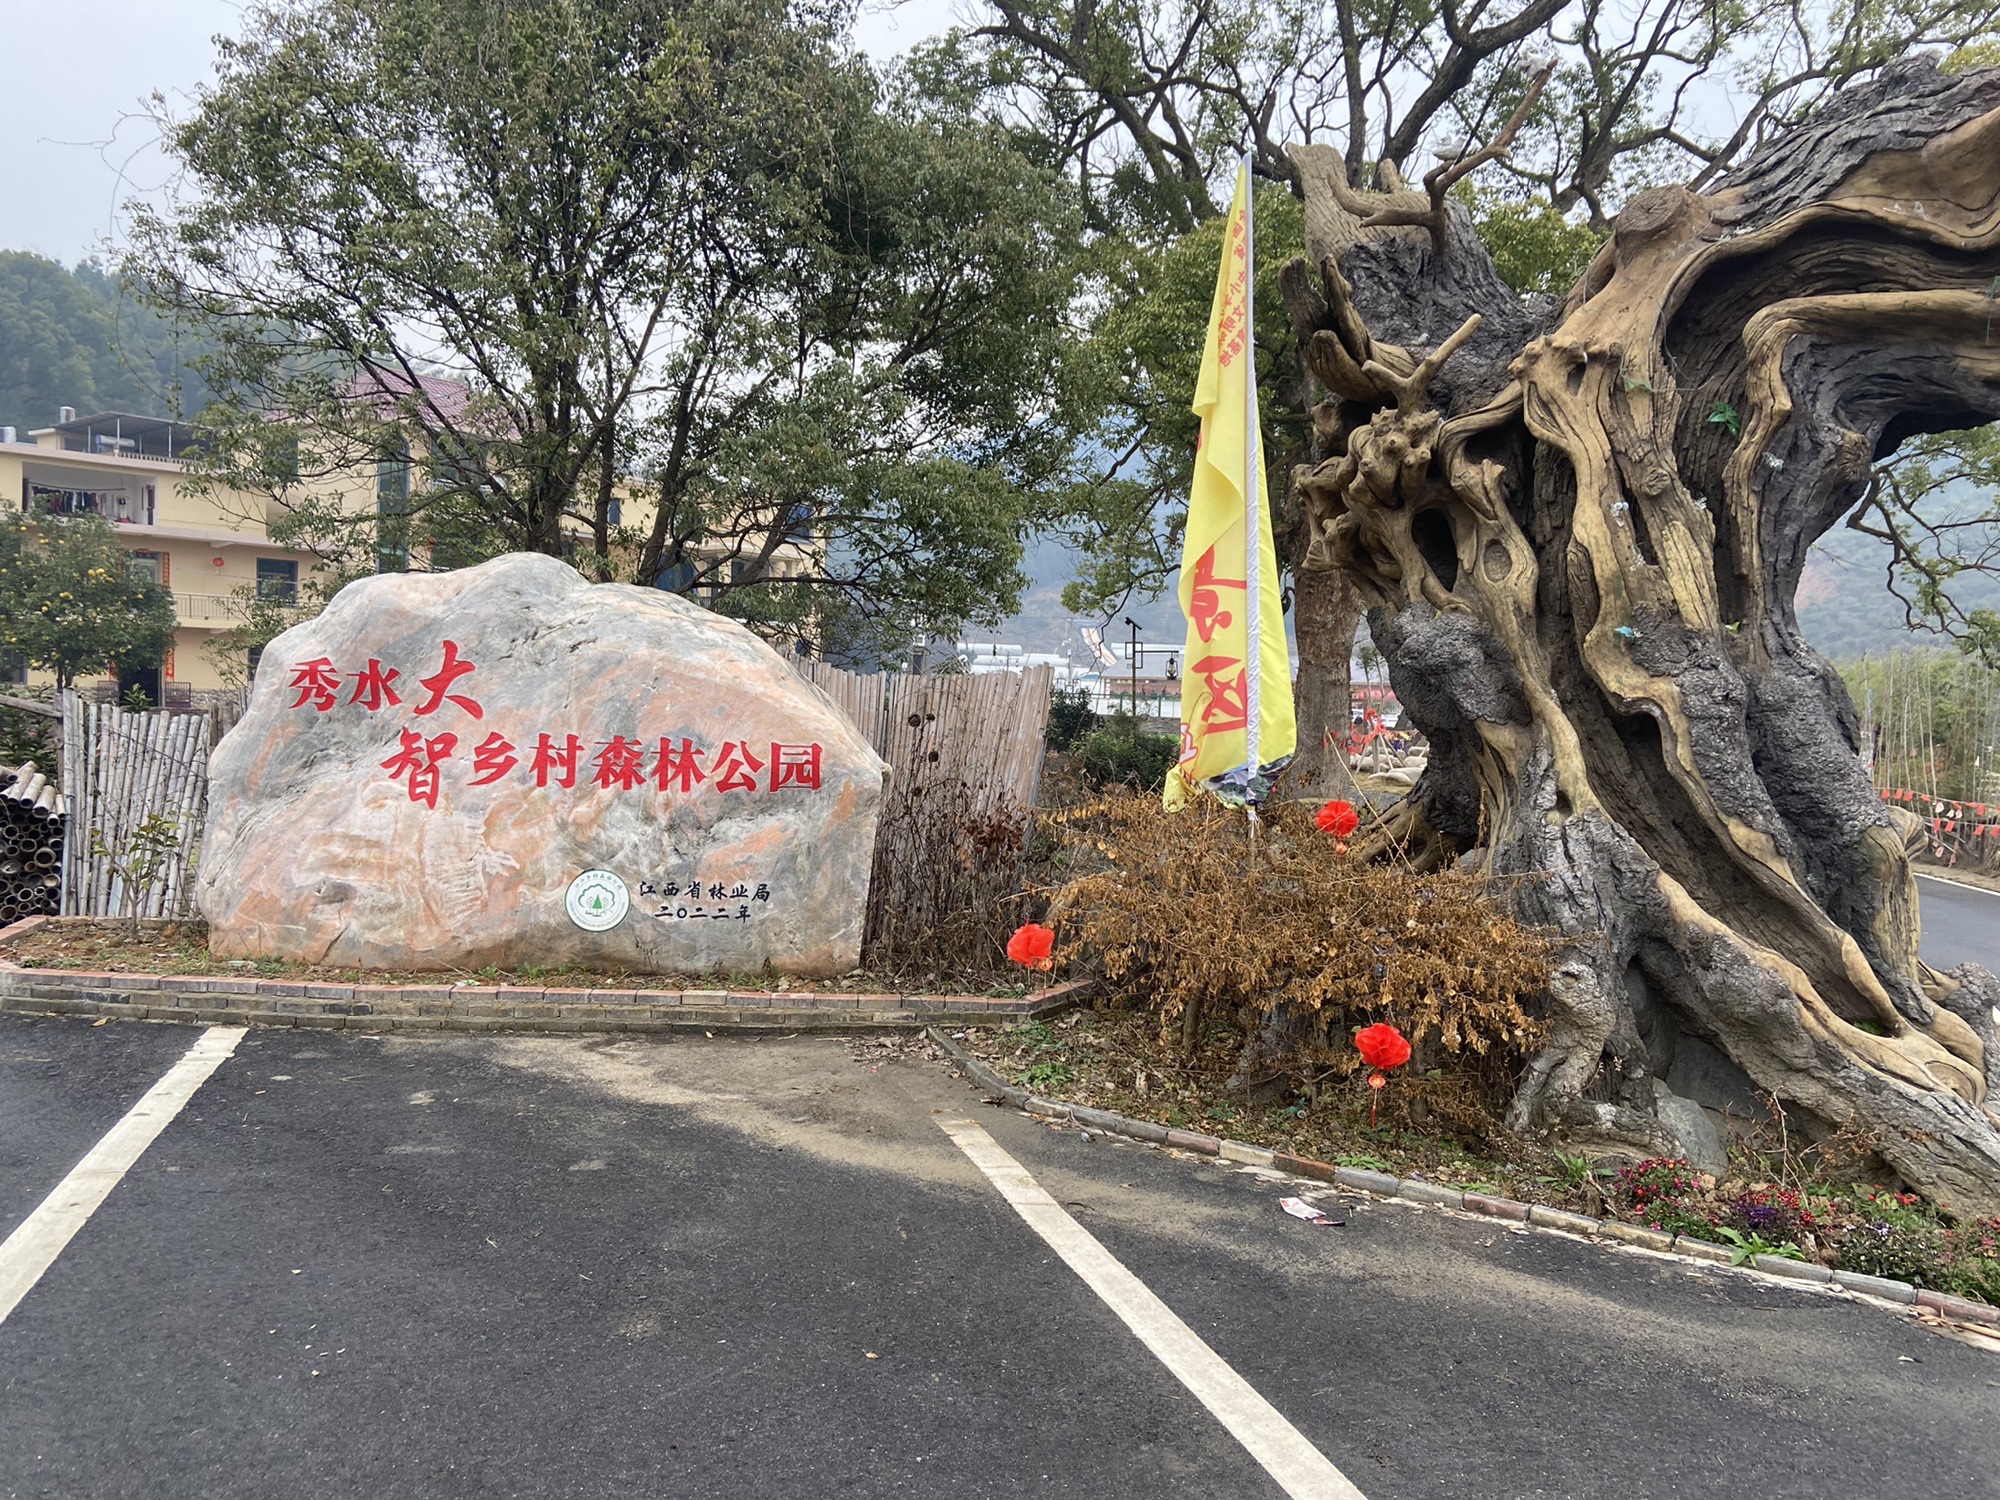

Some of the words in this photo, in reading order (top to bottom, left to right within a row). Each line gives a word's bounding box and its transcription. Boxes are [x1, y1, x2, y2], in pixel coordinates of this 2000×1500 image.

[639, 880, 771, 902] 江西省林业局
